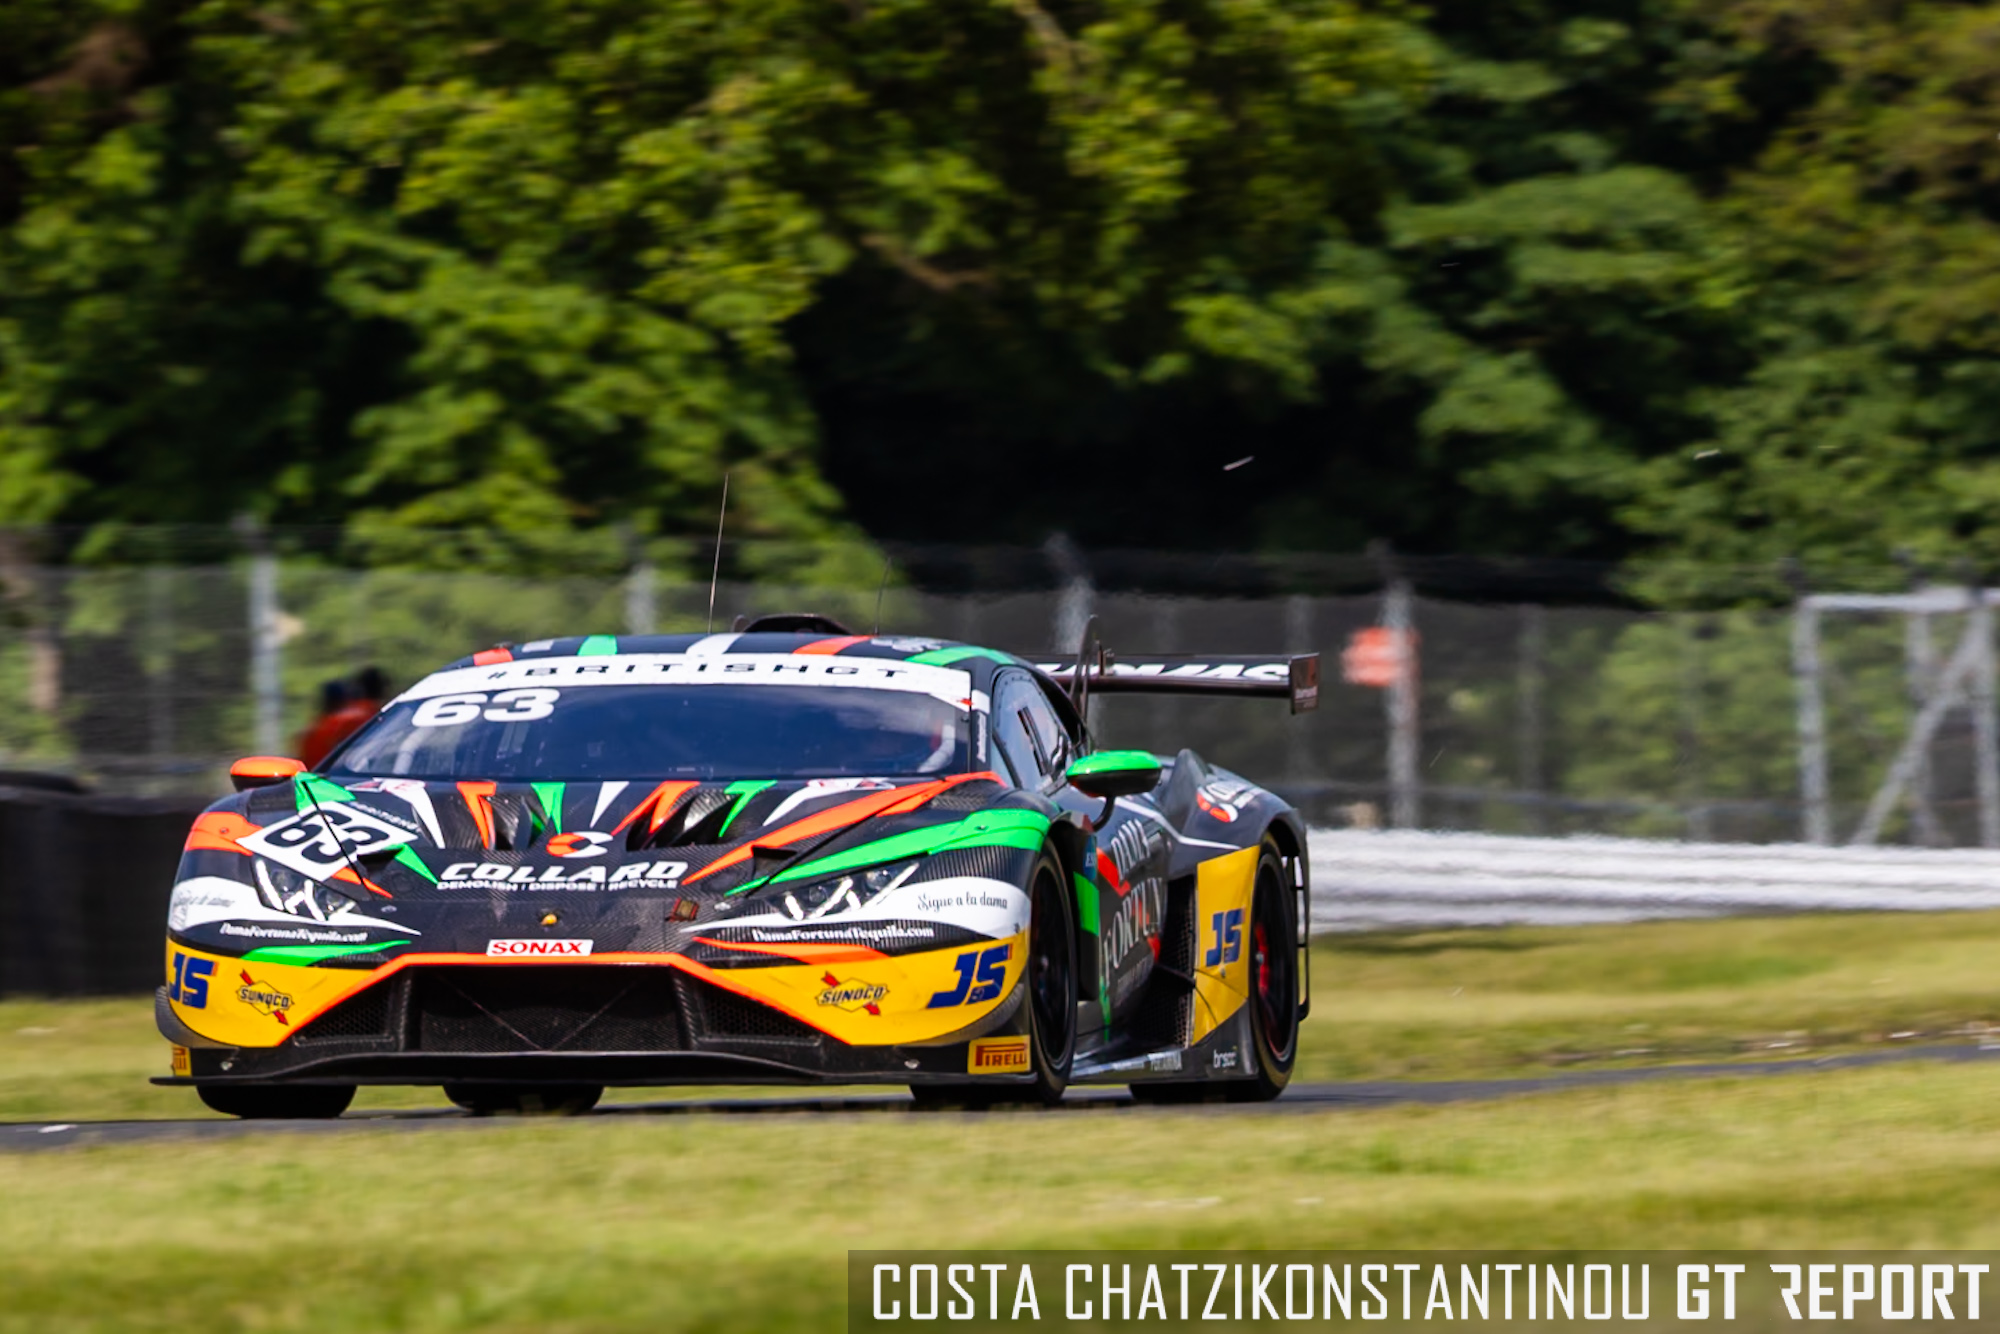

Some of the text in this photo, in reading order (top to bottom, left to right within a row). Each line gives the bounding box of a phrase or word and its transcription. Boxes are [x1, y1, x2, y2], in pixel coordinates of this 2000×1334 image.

[411, 688, 561, 727] 63
[264, 809, 391, 865] 63
[440, 861, 689, 883] COLLARD
[436, 879, 679, 892] DEMOLISH DISPOSE RECYCLE
[956, 896, 963, 906] a
[980, 891, 1008, 910] dama
[752, 925, 935, 943] DamaFortunaTequila.com
[1206, 907, 1246, 967] JS
[491, 942, 584, 955] SONAX
[169, 951, 219, 1009] JS
[926, 944, 1013, 1009] JS
[240, 987, 291, 1009] SUNOCO
[820, 985, 886, 1003] SUNOCO
